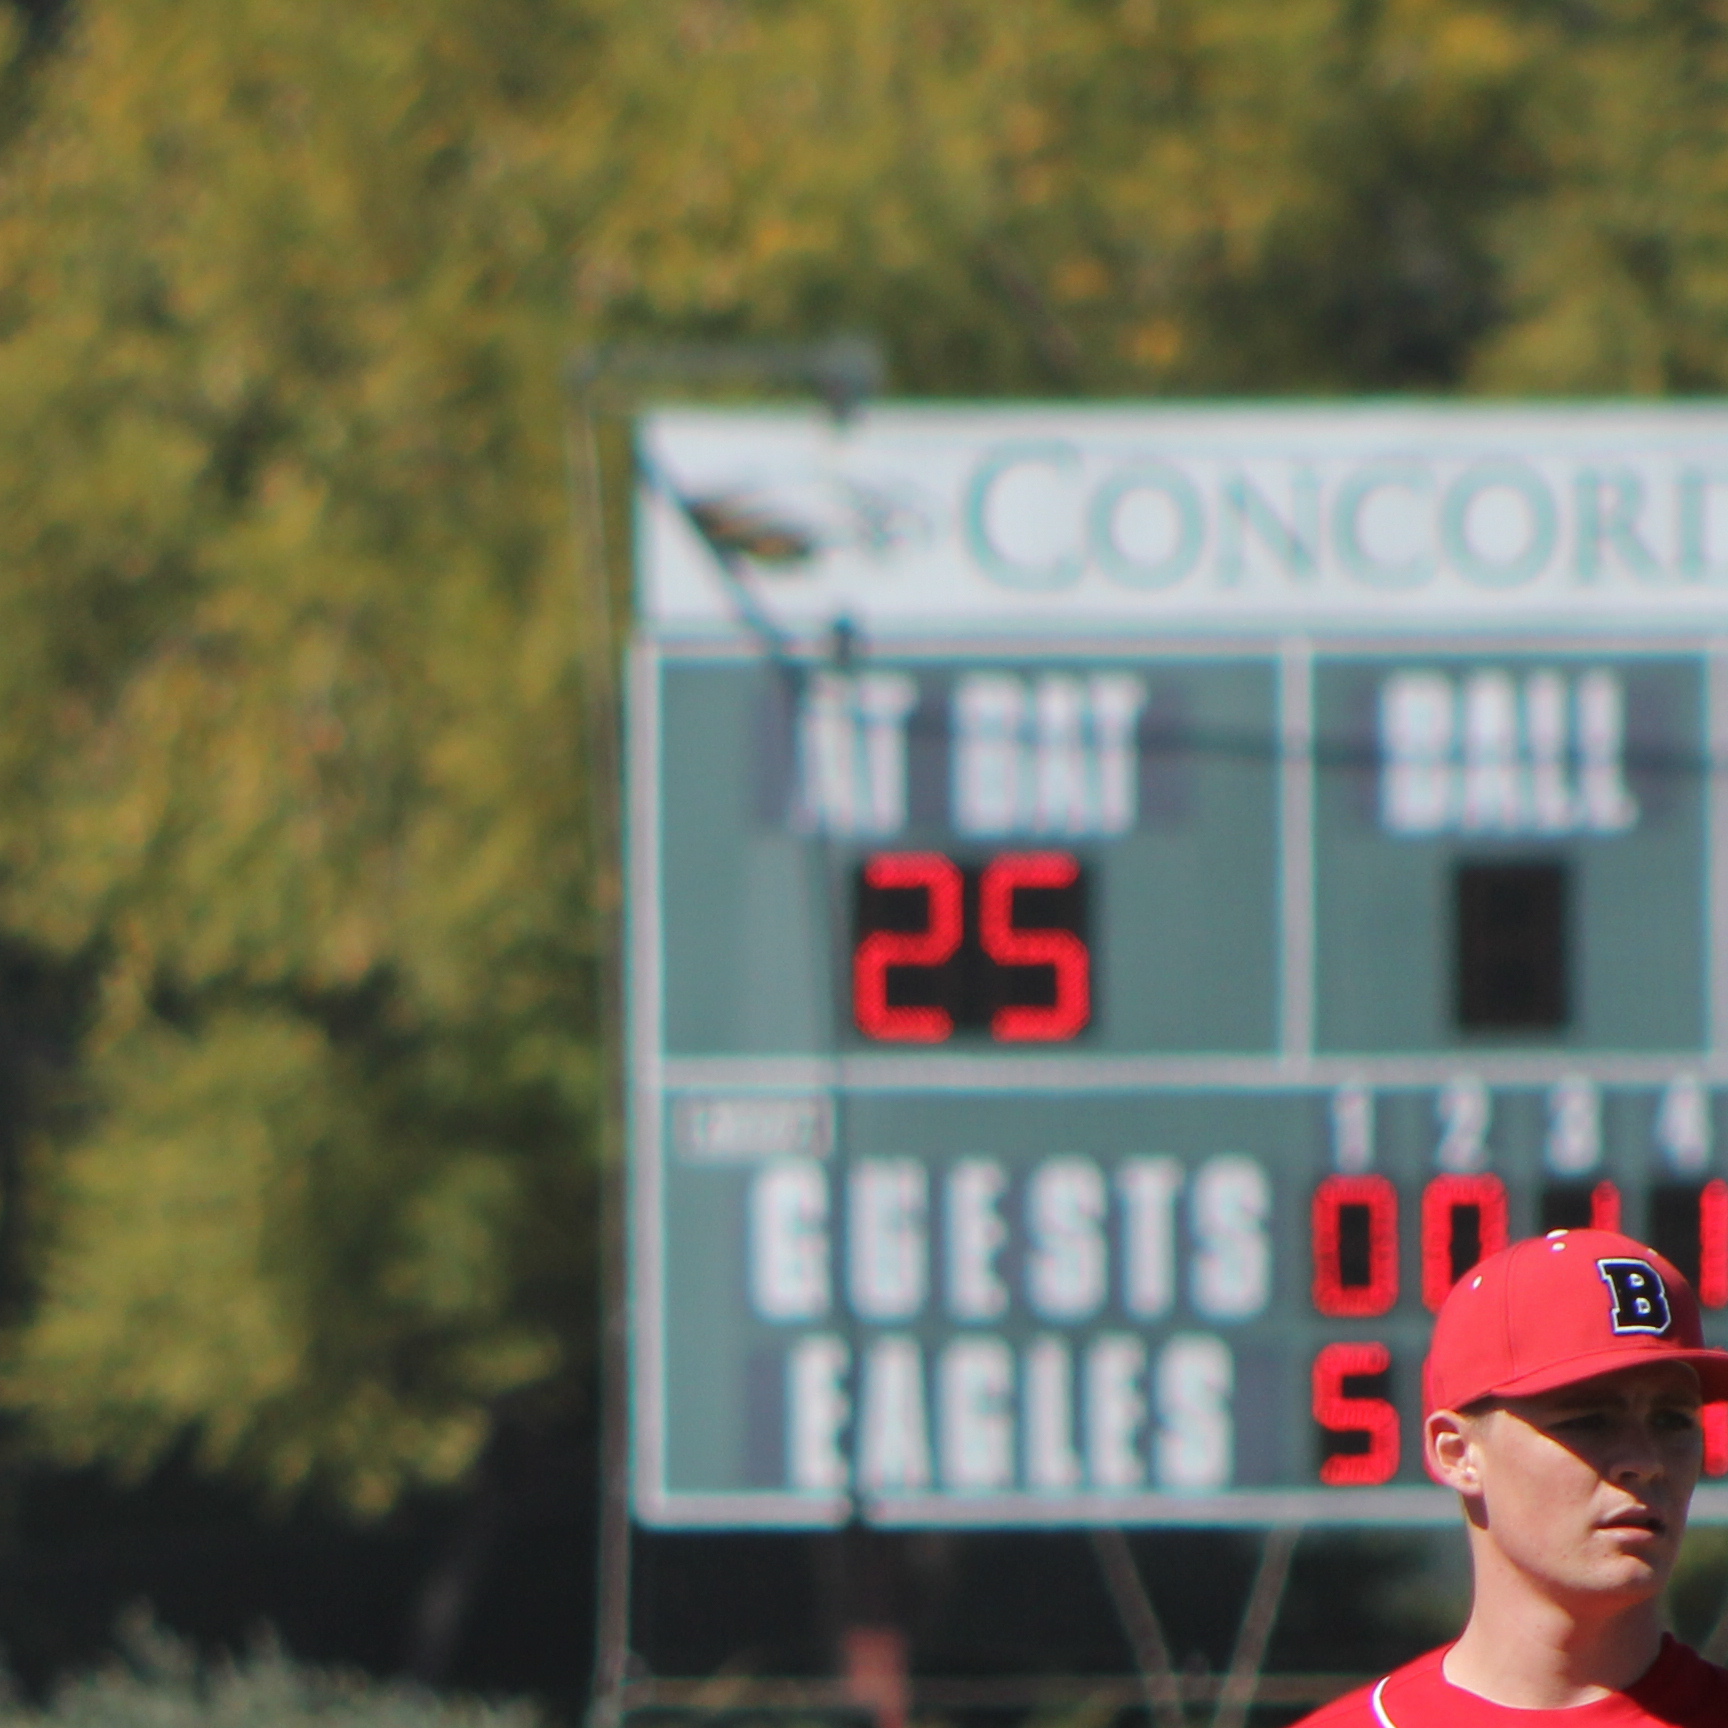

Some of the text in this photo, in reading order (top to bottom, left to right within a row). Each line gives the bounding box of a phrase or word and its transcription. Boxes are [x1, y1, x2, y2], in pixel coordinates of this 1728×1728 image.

[952, 670, 1145, 835] BAT
[1378, 669, 1638, 832] BALL
[855, 853, 1090, 1044] 25
[1332, 1072, 1374, 1172] 1
[1435, 1072, 1490, 1172] 2
[1654, 1072, 1712, 1172] 4
[1312, 1173, 1399, 1317] 0
[1596, 1258, 1672, 1335] B
[787, 1334, 1235, 1490] EAGLES
[1312, 1342, 1400, 1487] 5
